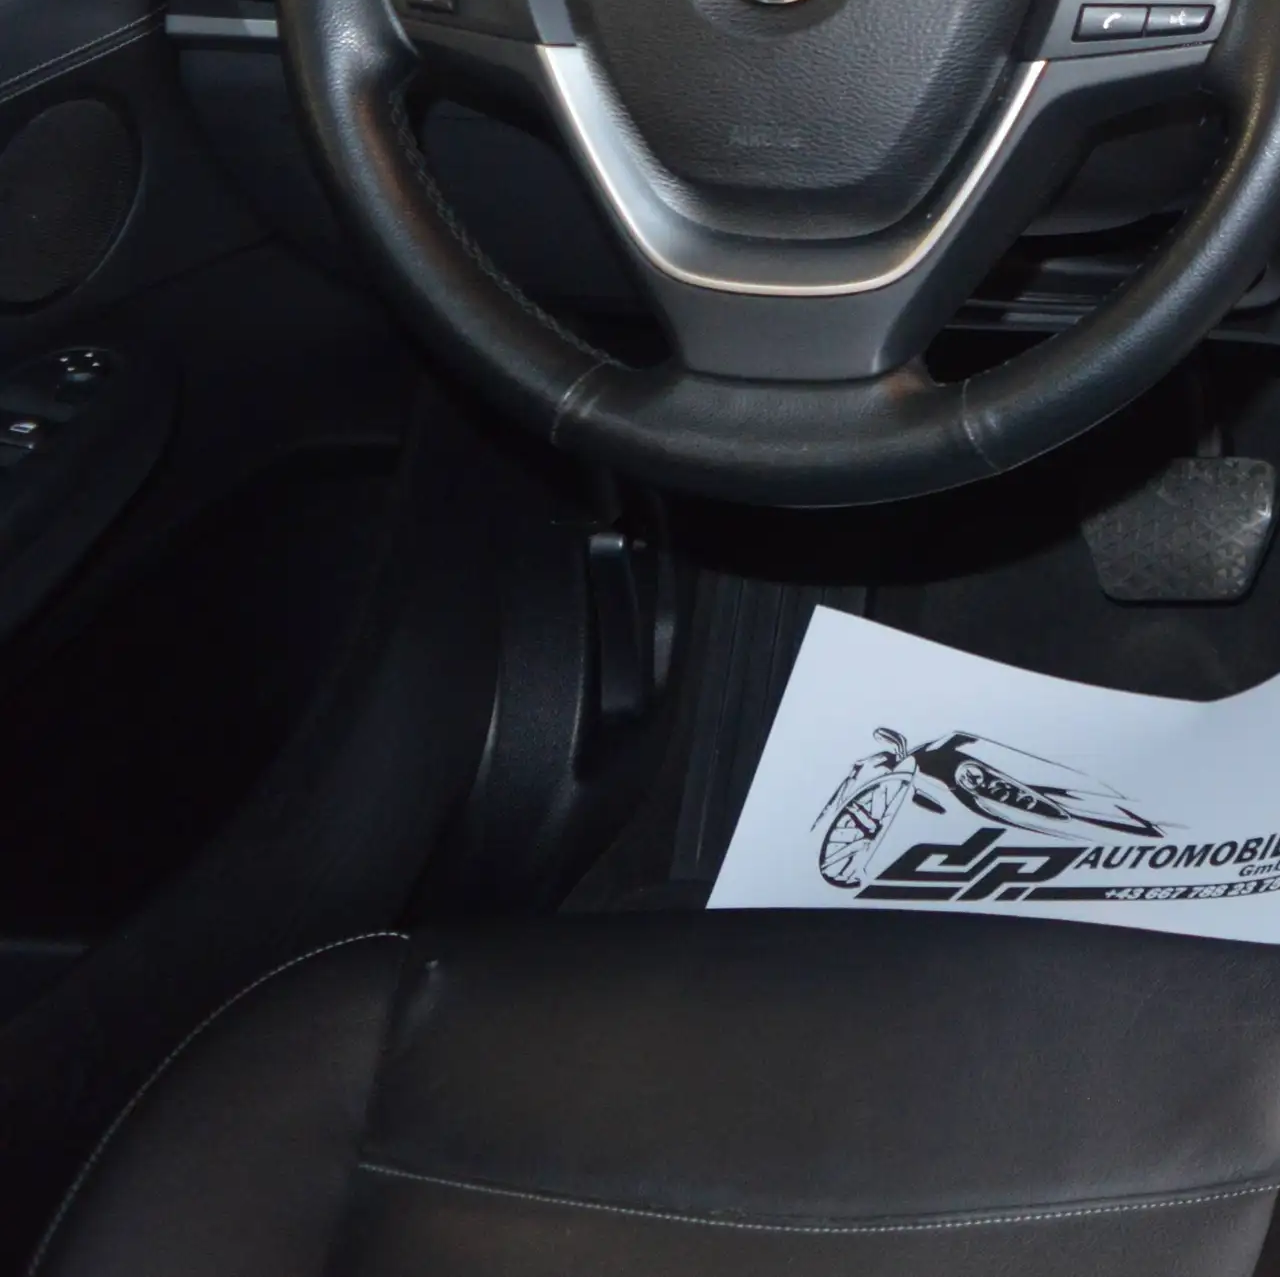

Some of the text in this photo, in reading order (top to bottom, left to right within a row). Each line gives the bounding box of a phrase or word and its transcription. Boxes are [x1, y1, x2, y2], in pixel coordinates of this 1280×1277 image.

[1105, 887, 1143, 900] +43
[1144, 885, 1187, 900] 667
[1187, 883, 1229, 899] 788
[1228, 880, 1256, 897] 23
